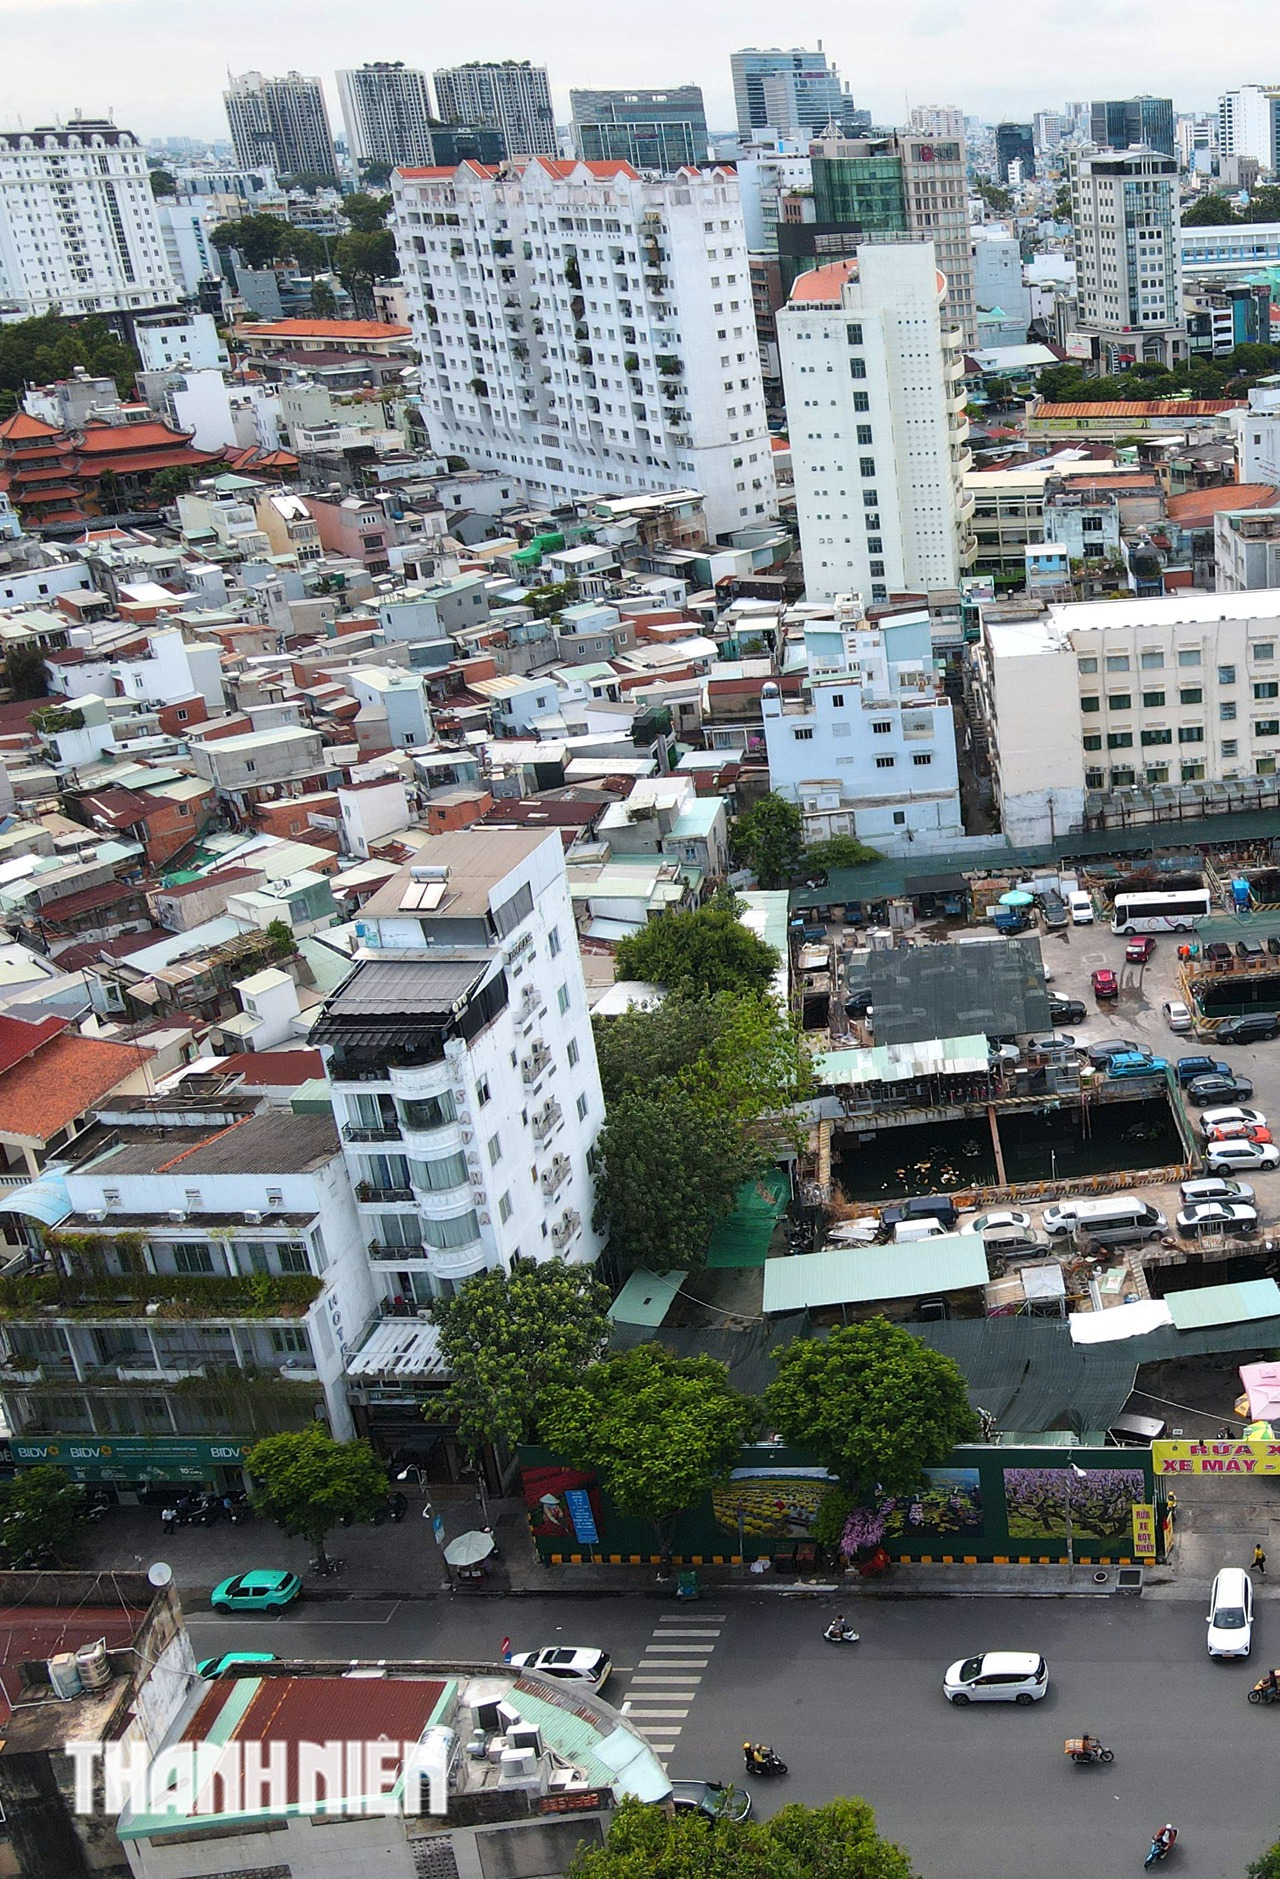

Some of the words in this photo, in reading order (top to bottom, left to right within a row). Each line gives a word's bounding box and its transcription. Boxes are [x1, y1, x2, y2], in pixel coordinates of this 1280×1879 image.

[455, 1089, 491, 1226] SAVANNA
[18, 1447, 48, 1458] BIDV
[70, 1447, 100, 1458] BIDV
[210, 1447, 241, 1458] BIDV
[1189, 1442, 1254, 1456] RỬA
[1162, 1459, 1194, 1473] XE
[1202, 1457, 1259, 1473] MÁY
[1139, 1521, 1149, 1530] XE
